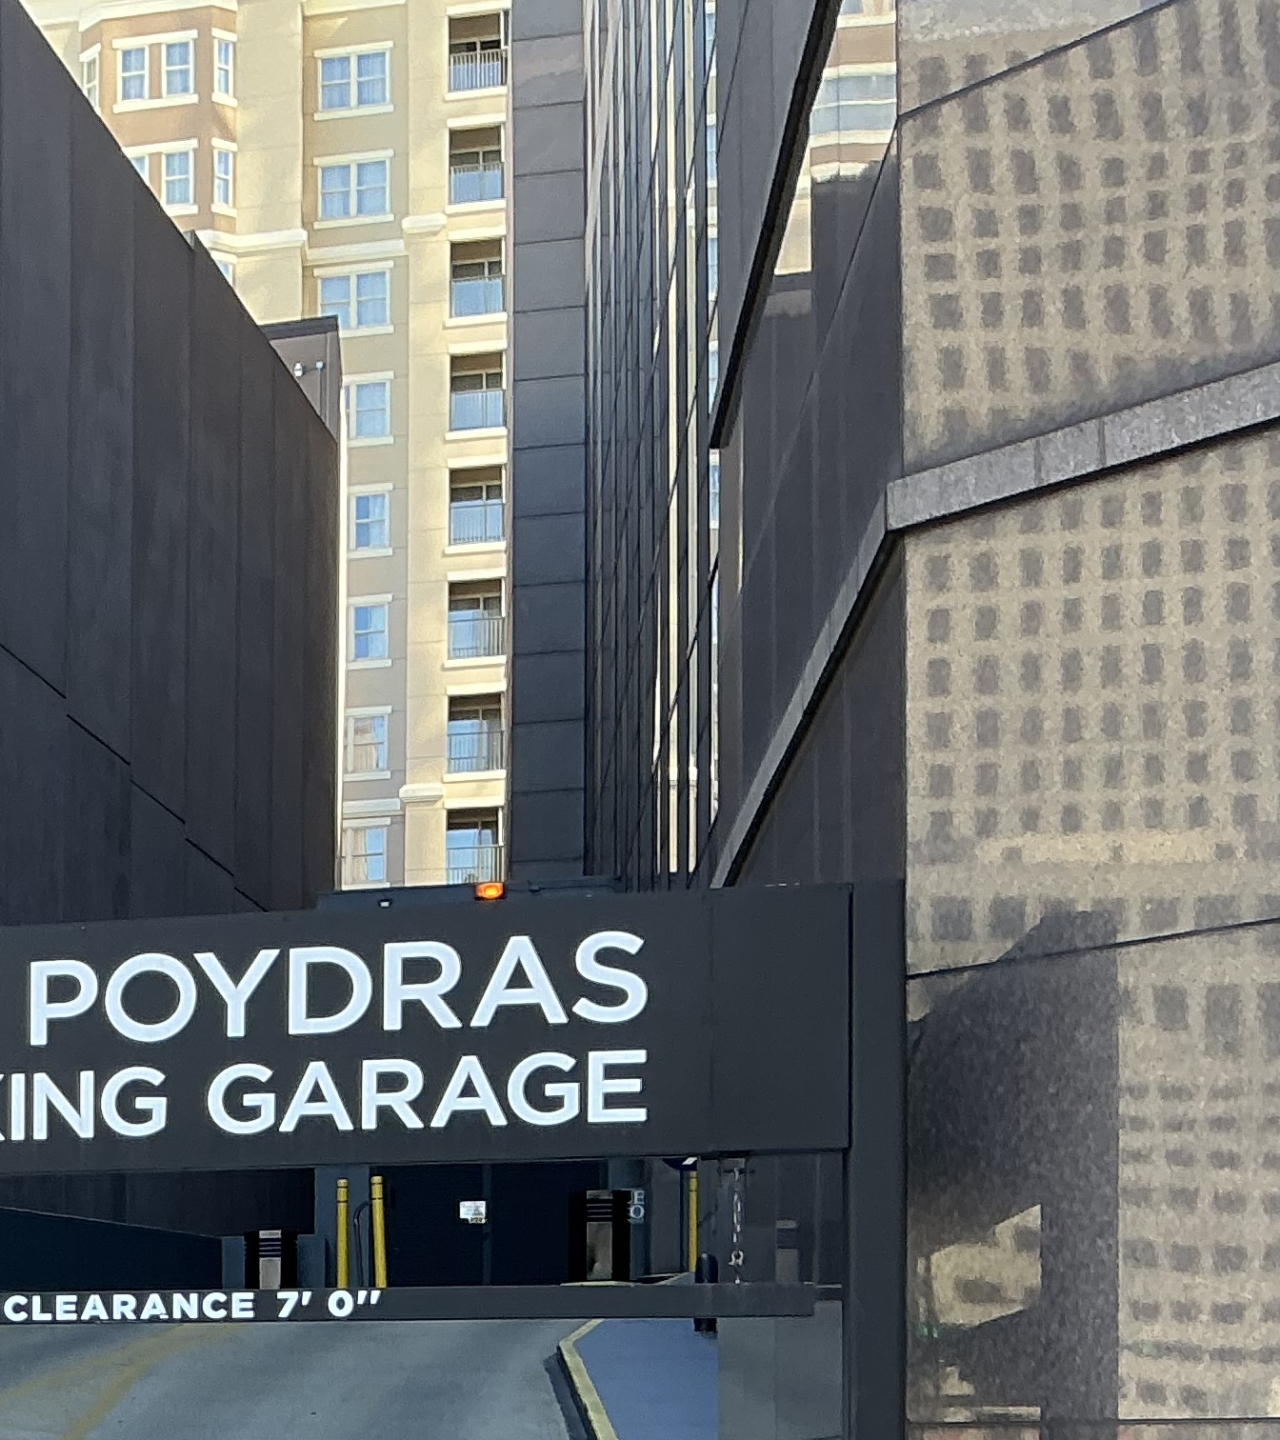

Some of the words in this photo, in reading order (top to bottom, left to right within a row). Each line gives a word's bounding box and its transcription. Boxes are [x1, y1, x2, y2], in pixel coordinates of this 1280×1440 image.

[30, 931, 648, 1046] POYDRAS
[208, 1050, 647, 1134] GARAGE
[4, 1292, 255, 1321] CLEARANCE
